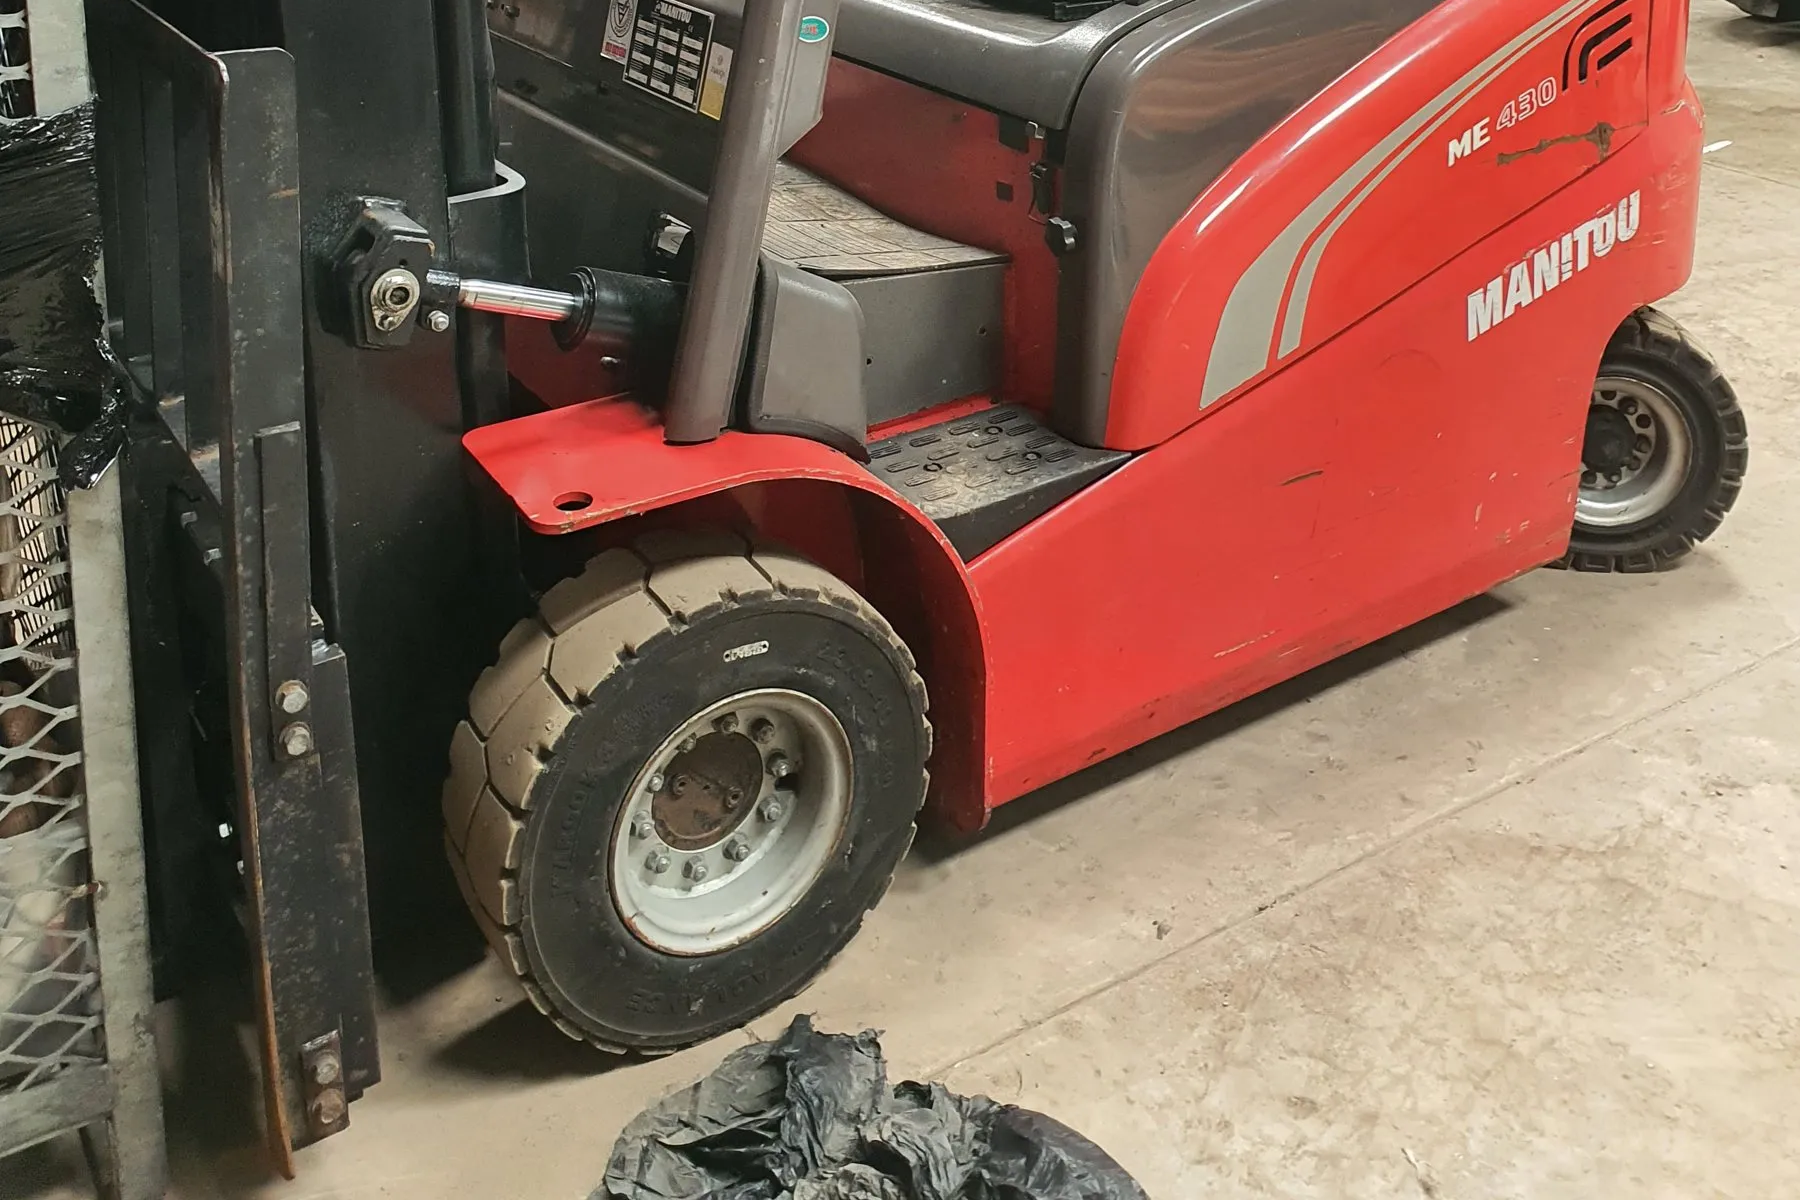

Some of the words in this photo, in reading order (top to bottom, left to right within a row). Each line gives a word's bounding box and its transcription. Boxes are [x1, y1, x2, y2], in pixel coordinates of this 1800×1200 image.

[660, 0, 692, 24] MANITOU
[1447, 116, 1491, 167] ME
[1496, 76, 1558, 130] 430
[1467, 189, 1641, 342] MANITOU
